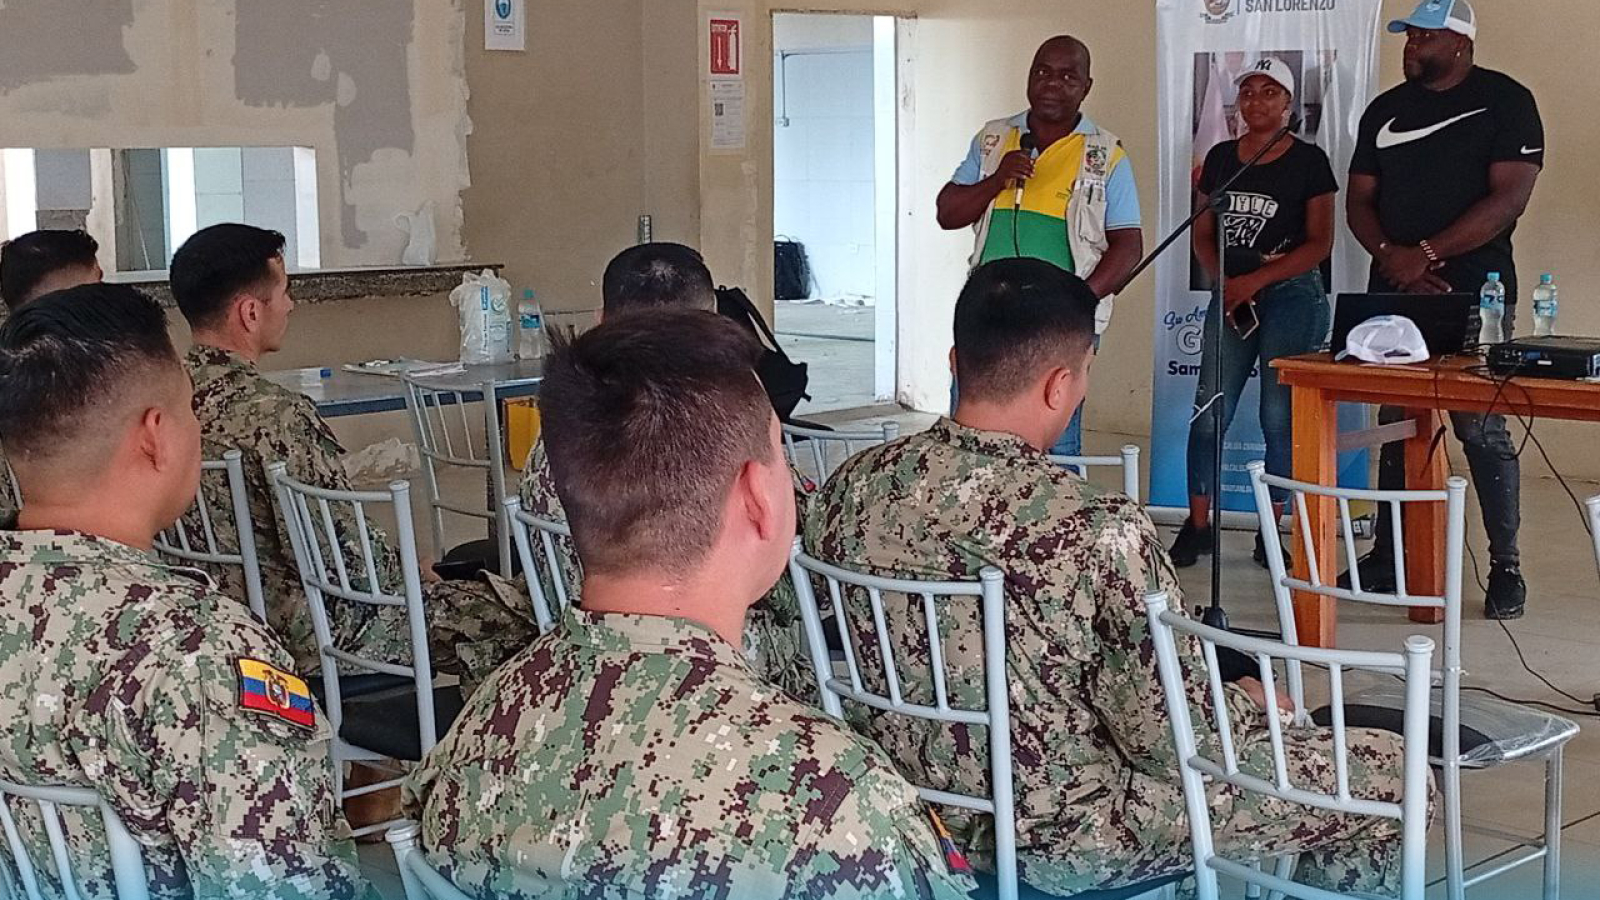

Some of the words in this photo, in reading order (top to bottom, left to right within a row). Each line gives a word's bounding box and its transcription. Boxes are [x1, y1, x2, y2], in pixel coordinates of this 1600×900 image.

[1245, 0, 1272, 13] SAN
[1275, 0, 1336, 12] LORENZO
[1229, 194, 1279, 219] YLE
